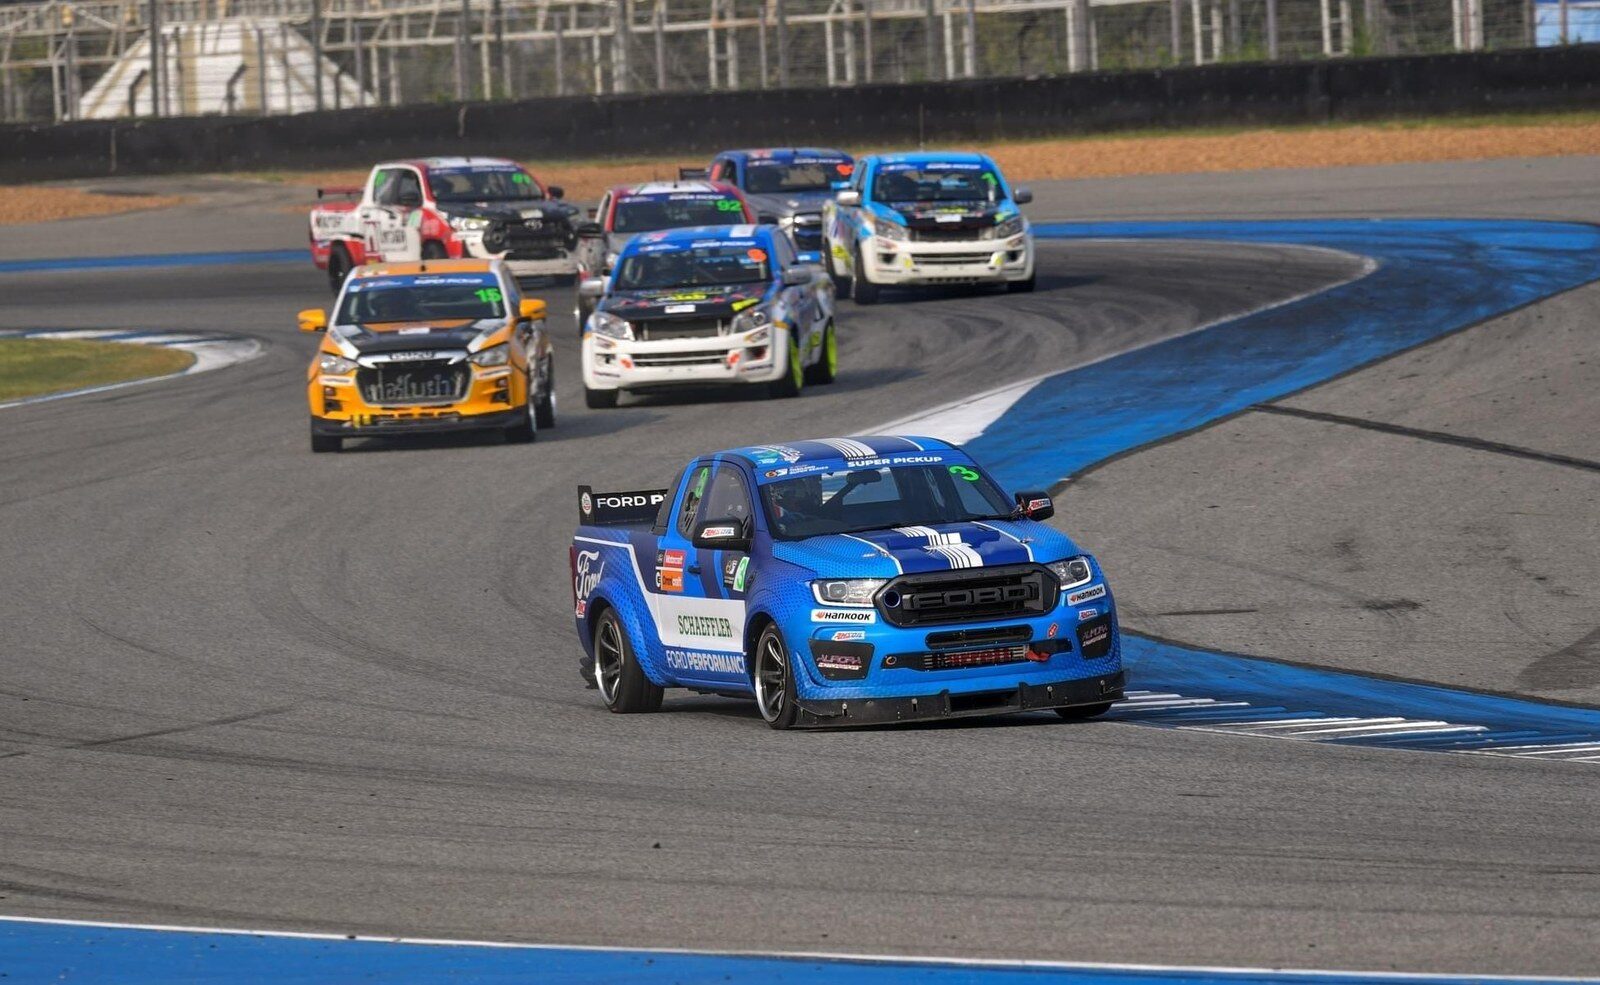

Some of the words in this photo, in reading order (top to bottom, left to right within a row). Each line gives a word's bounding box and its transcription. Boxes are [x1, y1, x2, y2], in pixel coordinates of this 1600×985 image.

[716, 201, 742, 212] 92
[847, 458, 891, 468] SUPER
[893, 456, 943, 464] PICKUP
[949, 465, 980, 482] 3
[597, 496, 647, 509] FORD
[651, 494, 667, 505] P
[902, 582, 1039, 610] FORD
[677, 614, 733, 638] SCHAEFFLER
[665, 649, 689, 670] FORD
